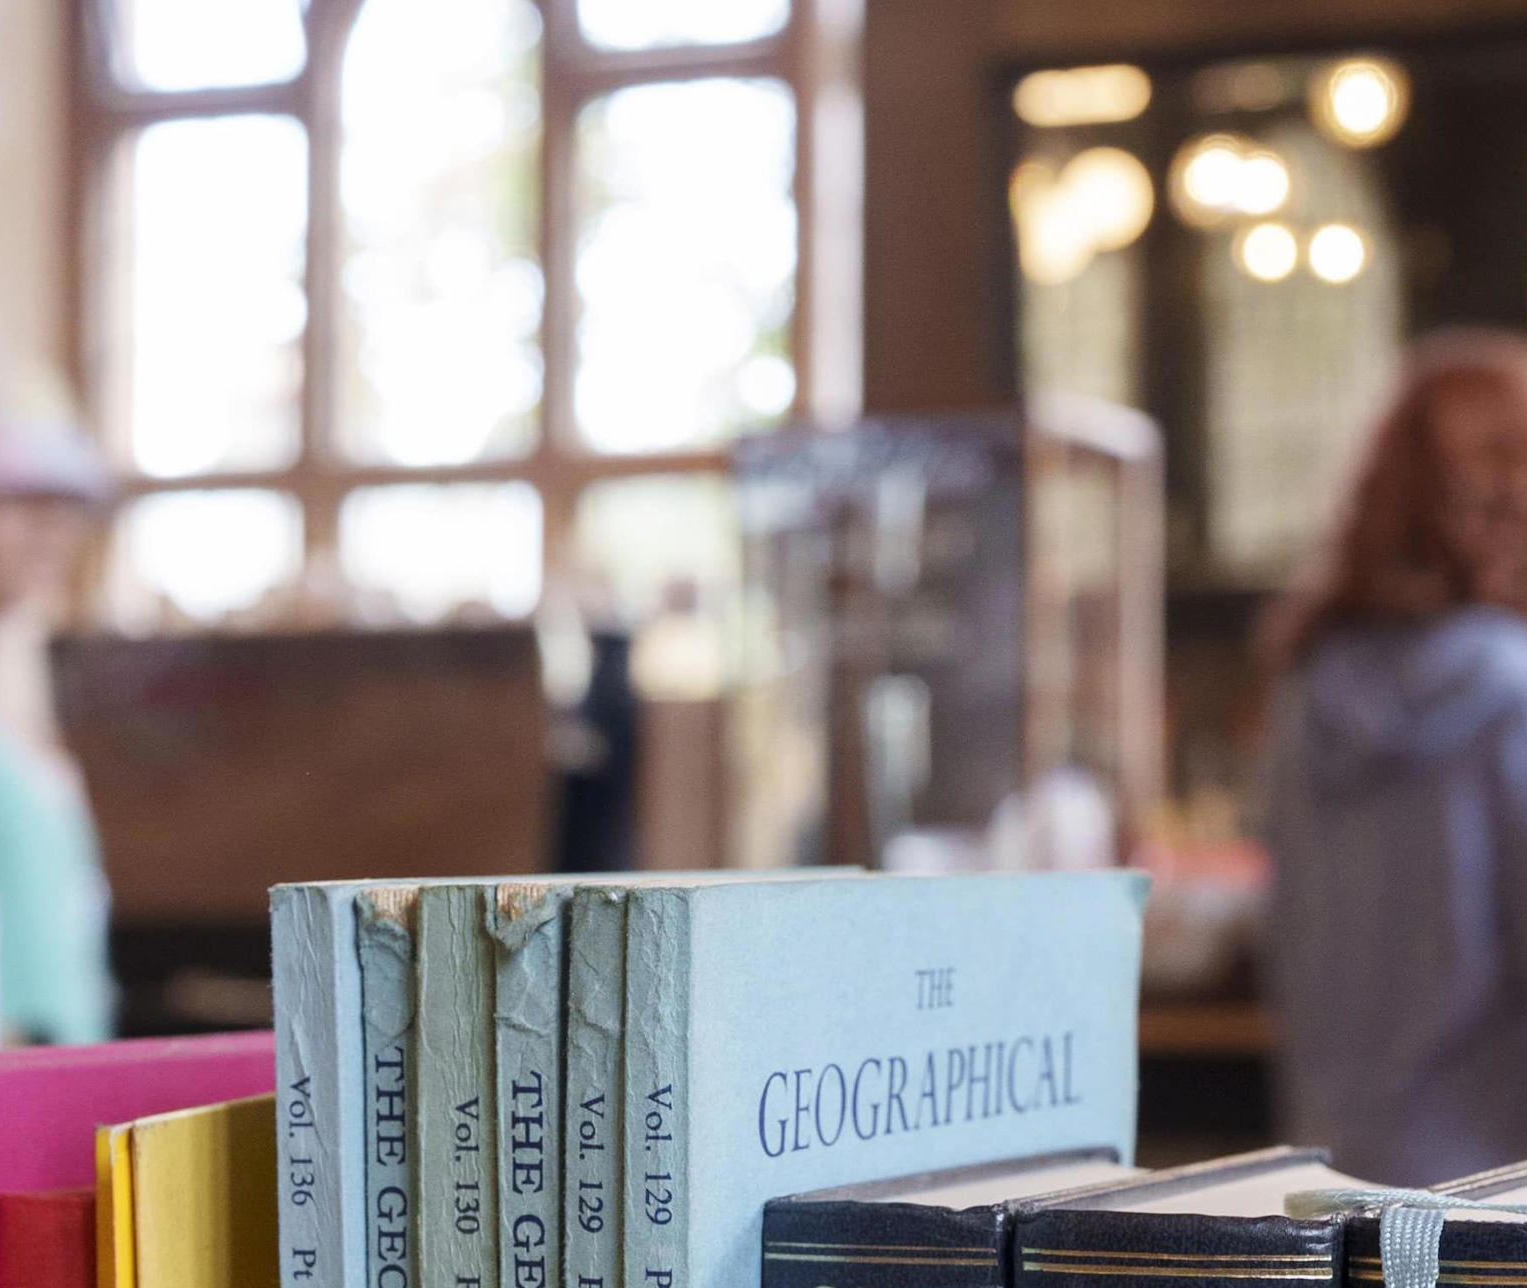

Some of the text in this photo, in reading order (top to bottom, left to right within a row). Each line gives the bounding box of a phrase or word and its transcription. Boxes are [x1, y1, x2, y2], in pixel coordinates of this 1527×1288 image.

[915, 968, 956, 1010] THE
[289, 1077, 312, 1139] Vol.
[374, 1047, 409, 1167] THE
[644, 1083, 673, 1152] Vol.
[758, 1030, 1082, 1158] GEOGRAPHICAL
[455, 1097, 480, 1162] Vol.
[510, 1070, 545, 1196] THE
[578, 1094, 606, 1160] Vol.
[290, 1155, 315, 1207] 136
[455, 1180, 481, 1236] 130
[577, 1179, 604, 1234] 129
[644, 1171, 673, 1226] 129
[292, 1247, 317, 1281] Pt
